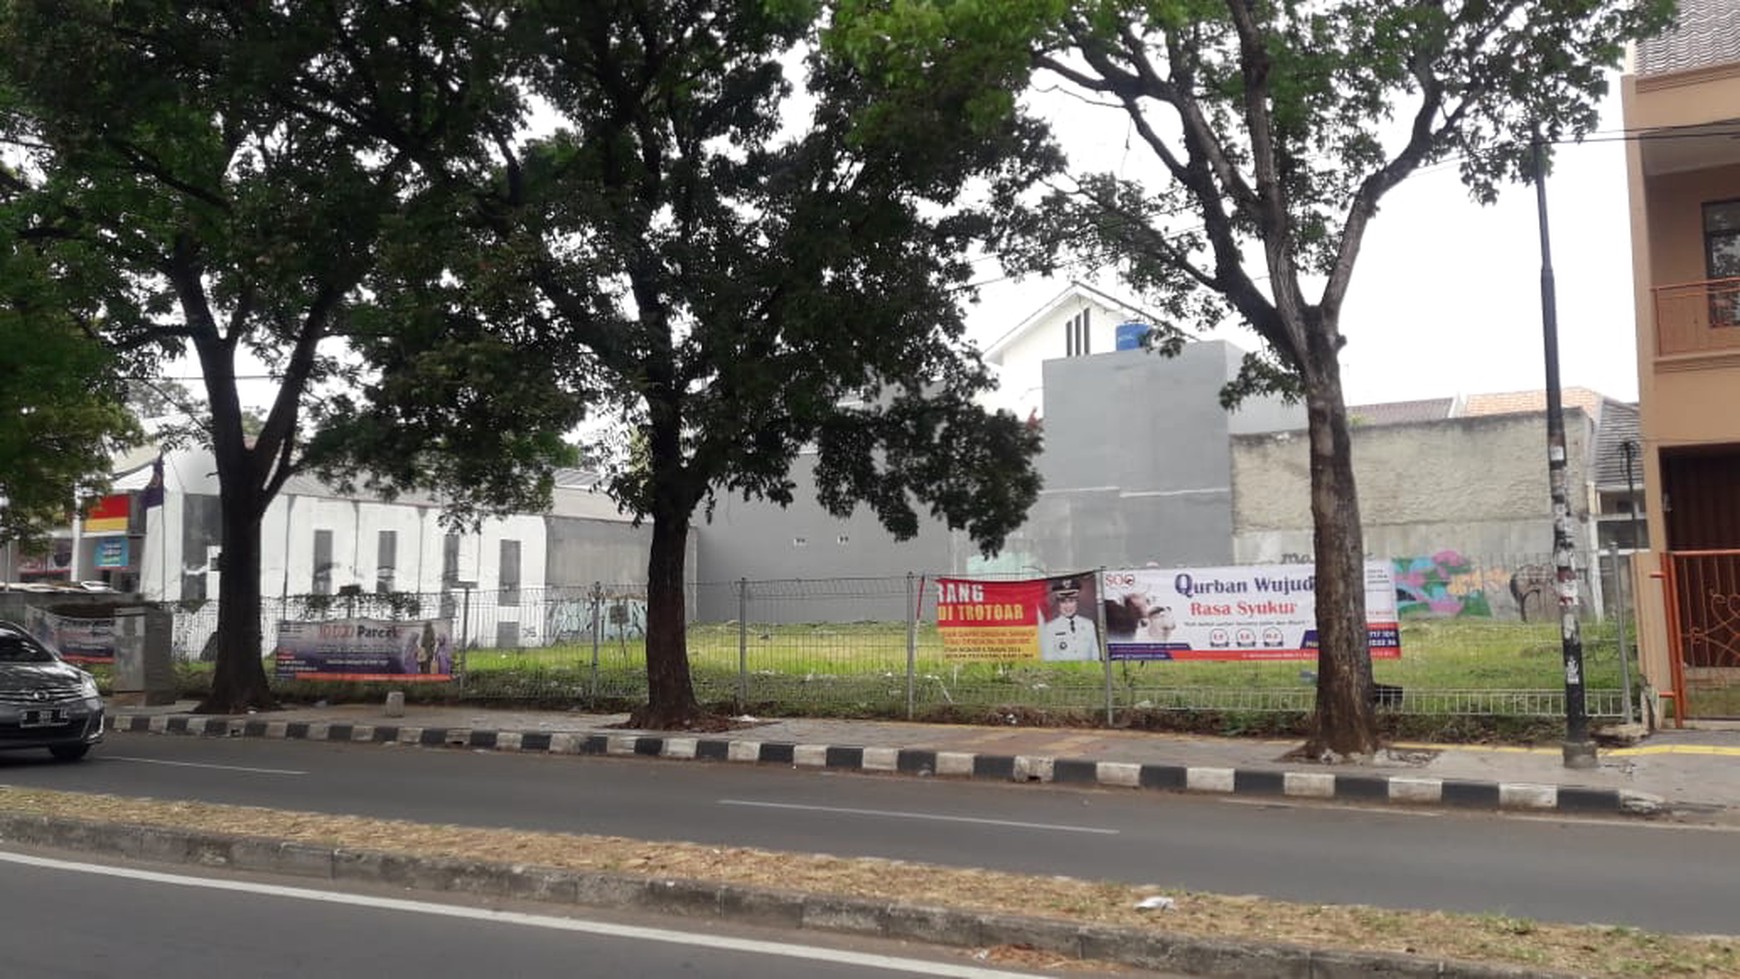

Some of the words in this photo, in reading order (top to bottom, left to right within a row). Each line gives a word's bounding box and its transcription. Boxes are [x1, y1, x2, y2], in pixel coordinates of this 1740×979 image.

[1175, 573, 1248, 598] Qurban
[957, 604, 1024, 621] TROTOAR
[1190, 602, 1231, 616] Rasa
[1237, 600, 1297, 618] Syukur
